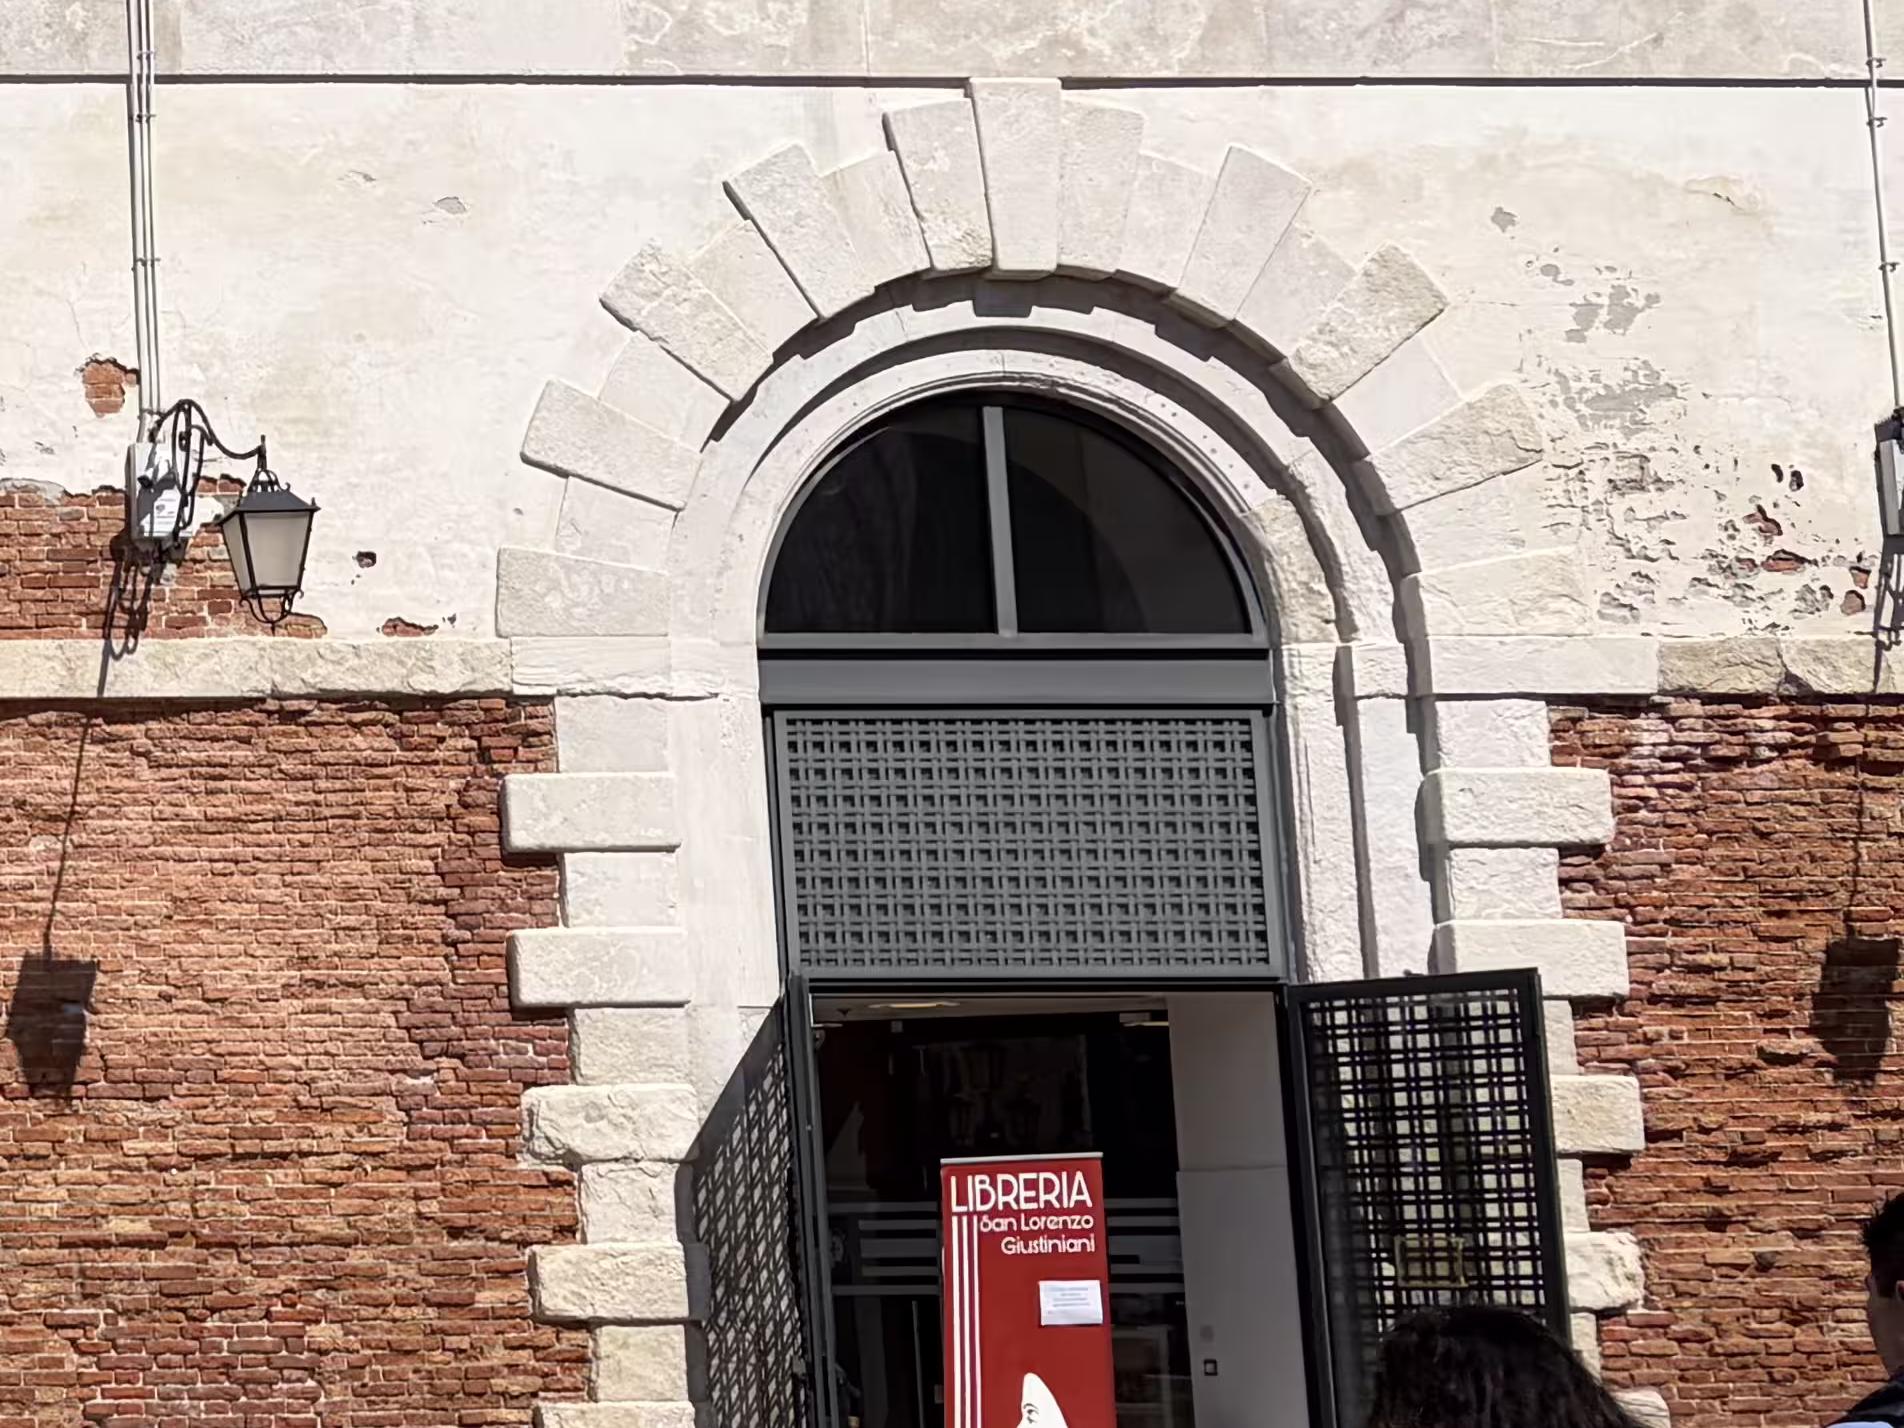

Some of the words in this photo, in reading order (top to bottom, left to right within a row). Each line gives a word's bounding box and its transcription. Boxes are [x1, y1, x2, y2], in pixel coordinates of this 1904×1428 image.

[950, 1170, 1093, 1213] LIBRERIA
[979, 1214, 1018, 1233] San
[1020, 1213, 1094, 1231] Lorenzo
[1000, 1233, 1096, 1255] Giustiniani
